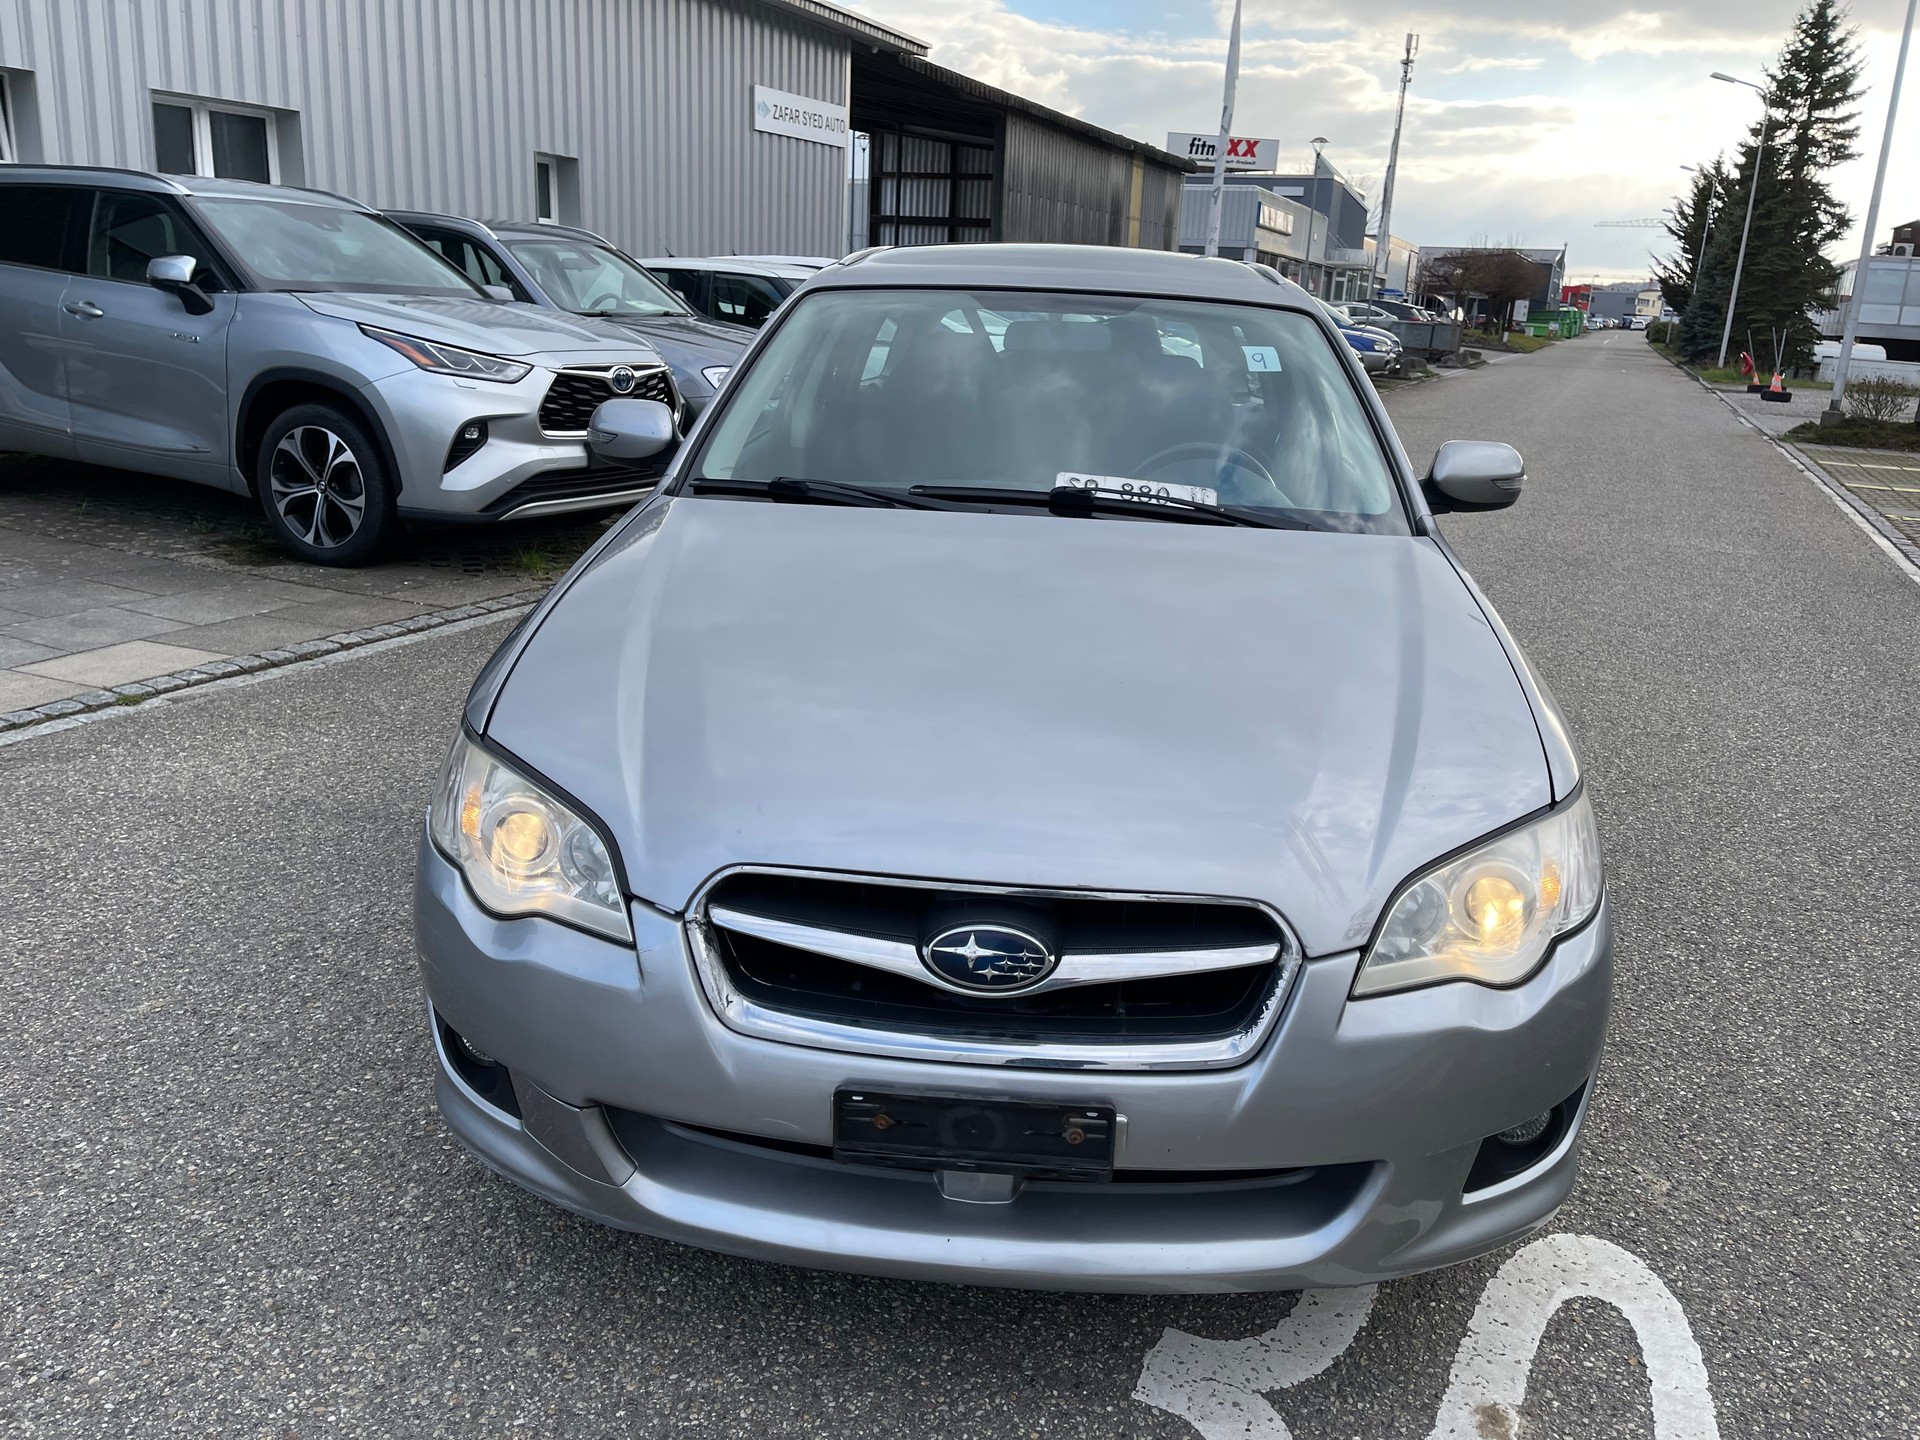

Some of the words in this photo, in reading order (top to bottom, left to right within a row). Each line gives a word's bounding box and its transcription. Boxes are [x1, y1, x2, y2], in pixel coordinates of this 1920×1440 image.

[772, 104, 801, 125] ZAFAR
[802, 111, 824, 129] SYED
[824, 116, 846, 134] AUTO
[1252, 352, 1268, 370] 9
[1121, 482, 1170, 505] 880
